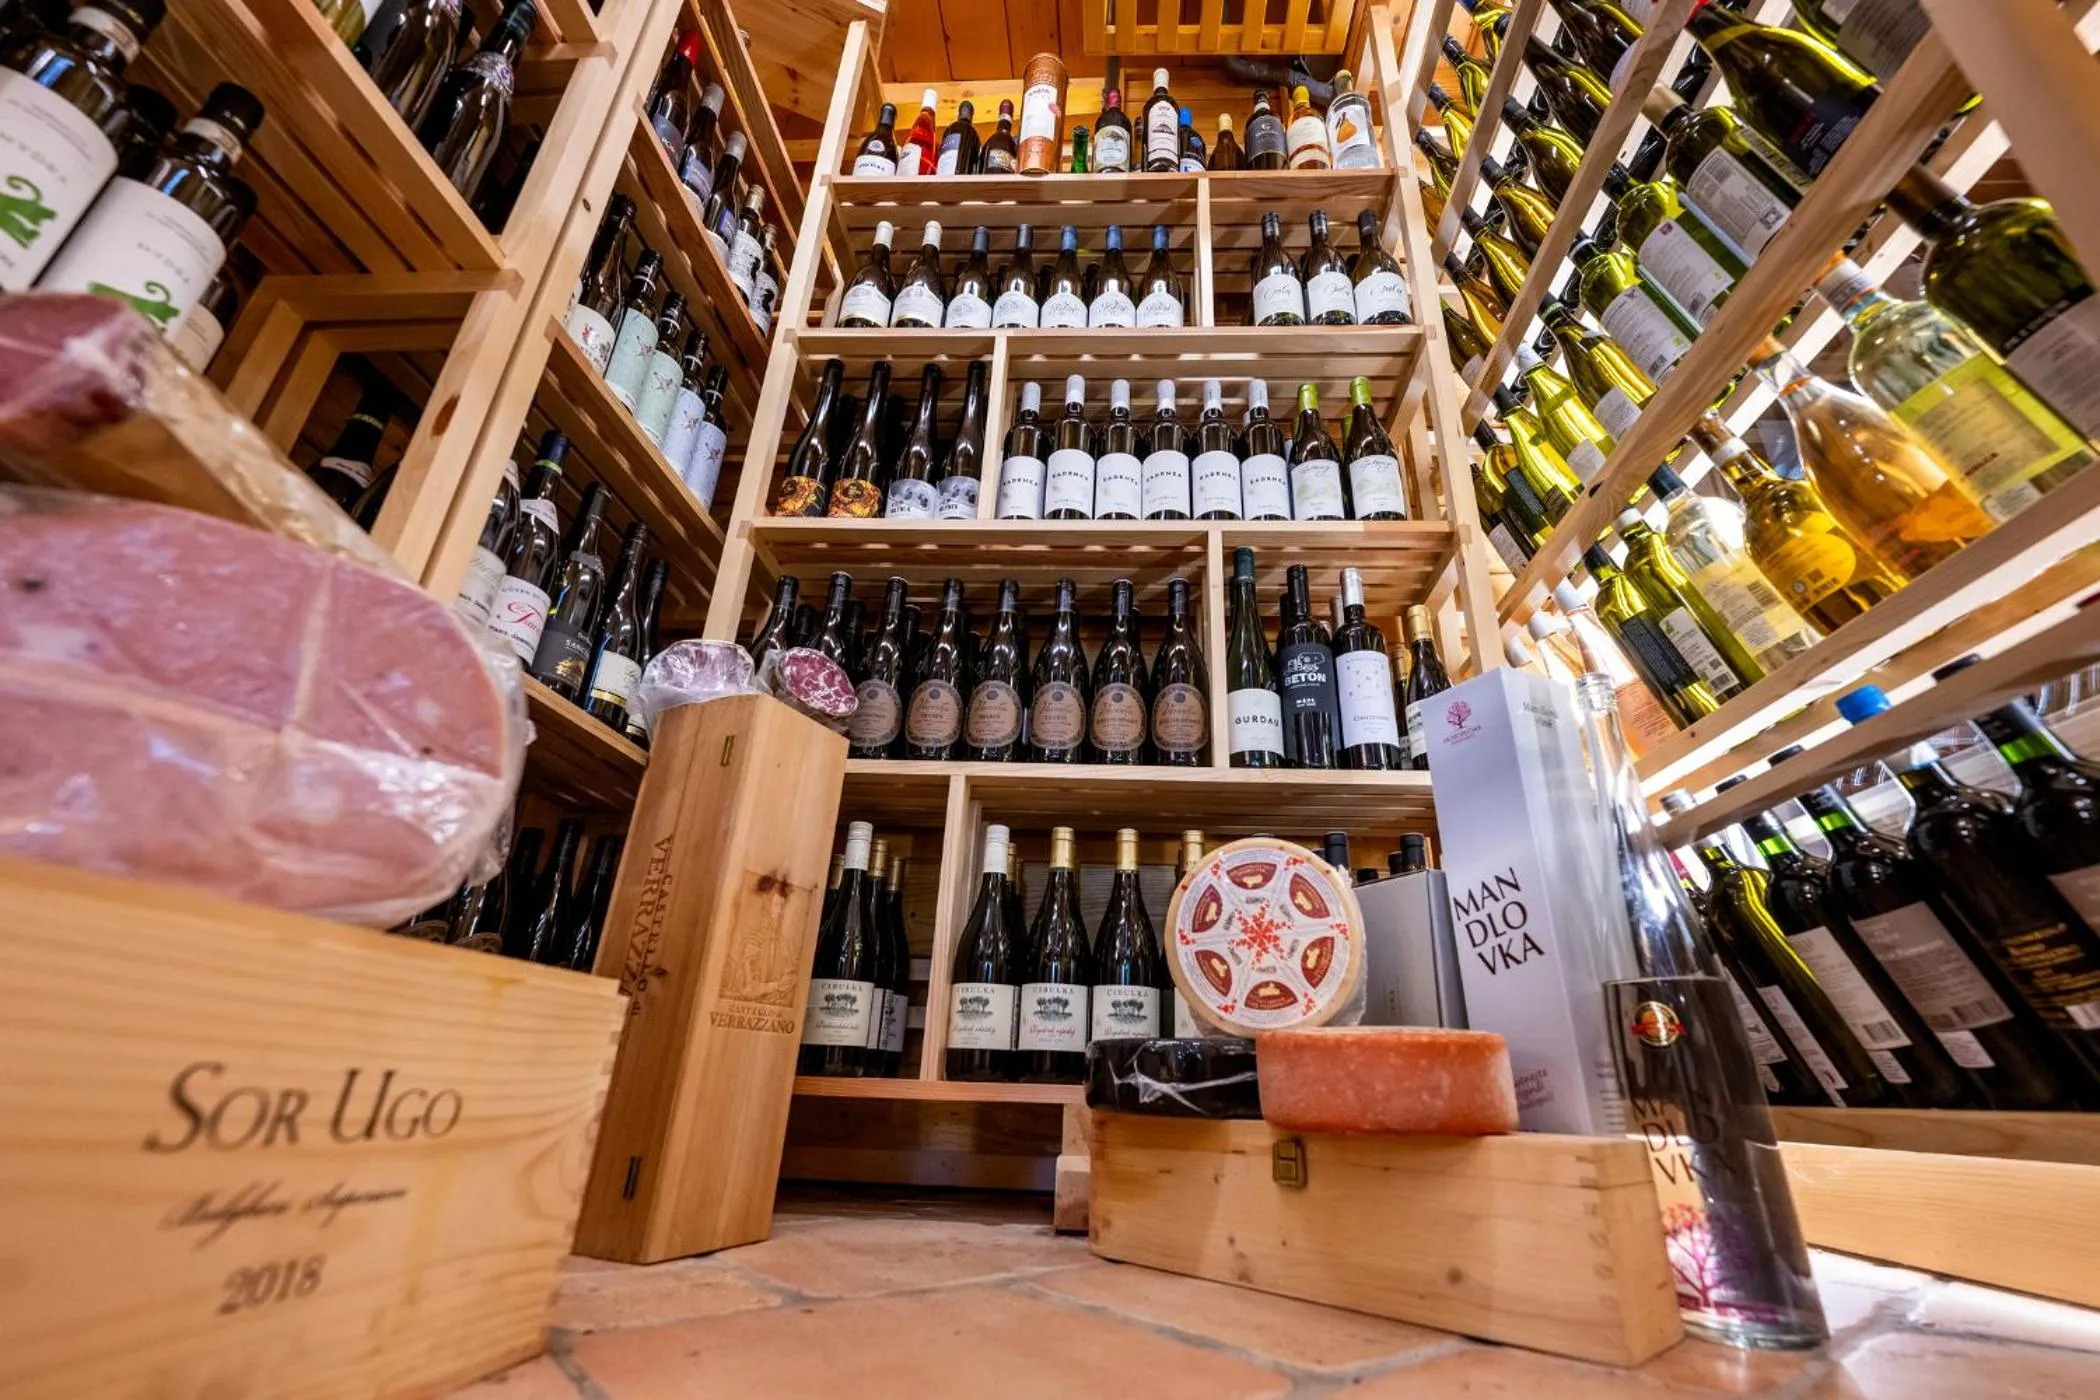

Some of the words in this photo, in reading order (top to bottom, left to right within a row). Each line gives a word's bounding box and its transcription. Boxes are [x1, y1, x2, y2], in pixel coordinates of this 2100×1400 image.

[1284, 672, 1327, 686] BETON
[1453, 867, 1521, 921] MAN
[1465, 901, 1528, 948] DLO
[1476, 932, 1545, 976] VKA
[1032, 986, 1075, 995] CIBULKA
[1106, 988, 1150, 998] CIBULKA
[709, 1011, 796, 1035] VERRAZZANO
[140, 1060, 309, 1153] SOR
[330, 1067, 464, 1144] UGO
[213, 1252, 328, 1316] 2018
